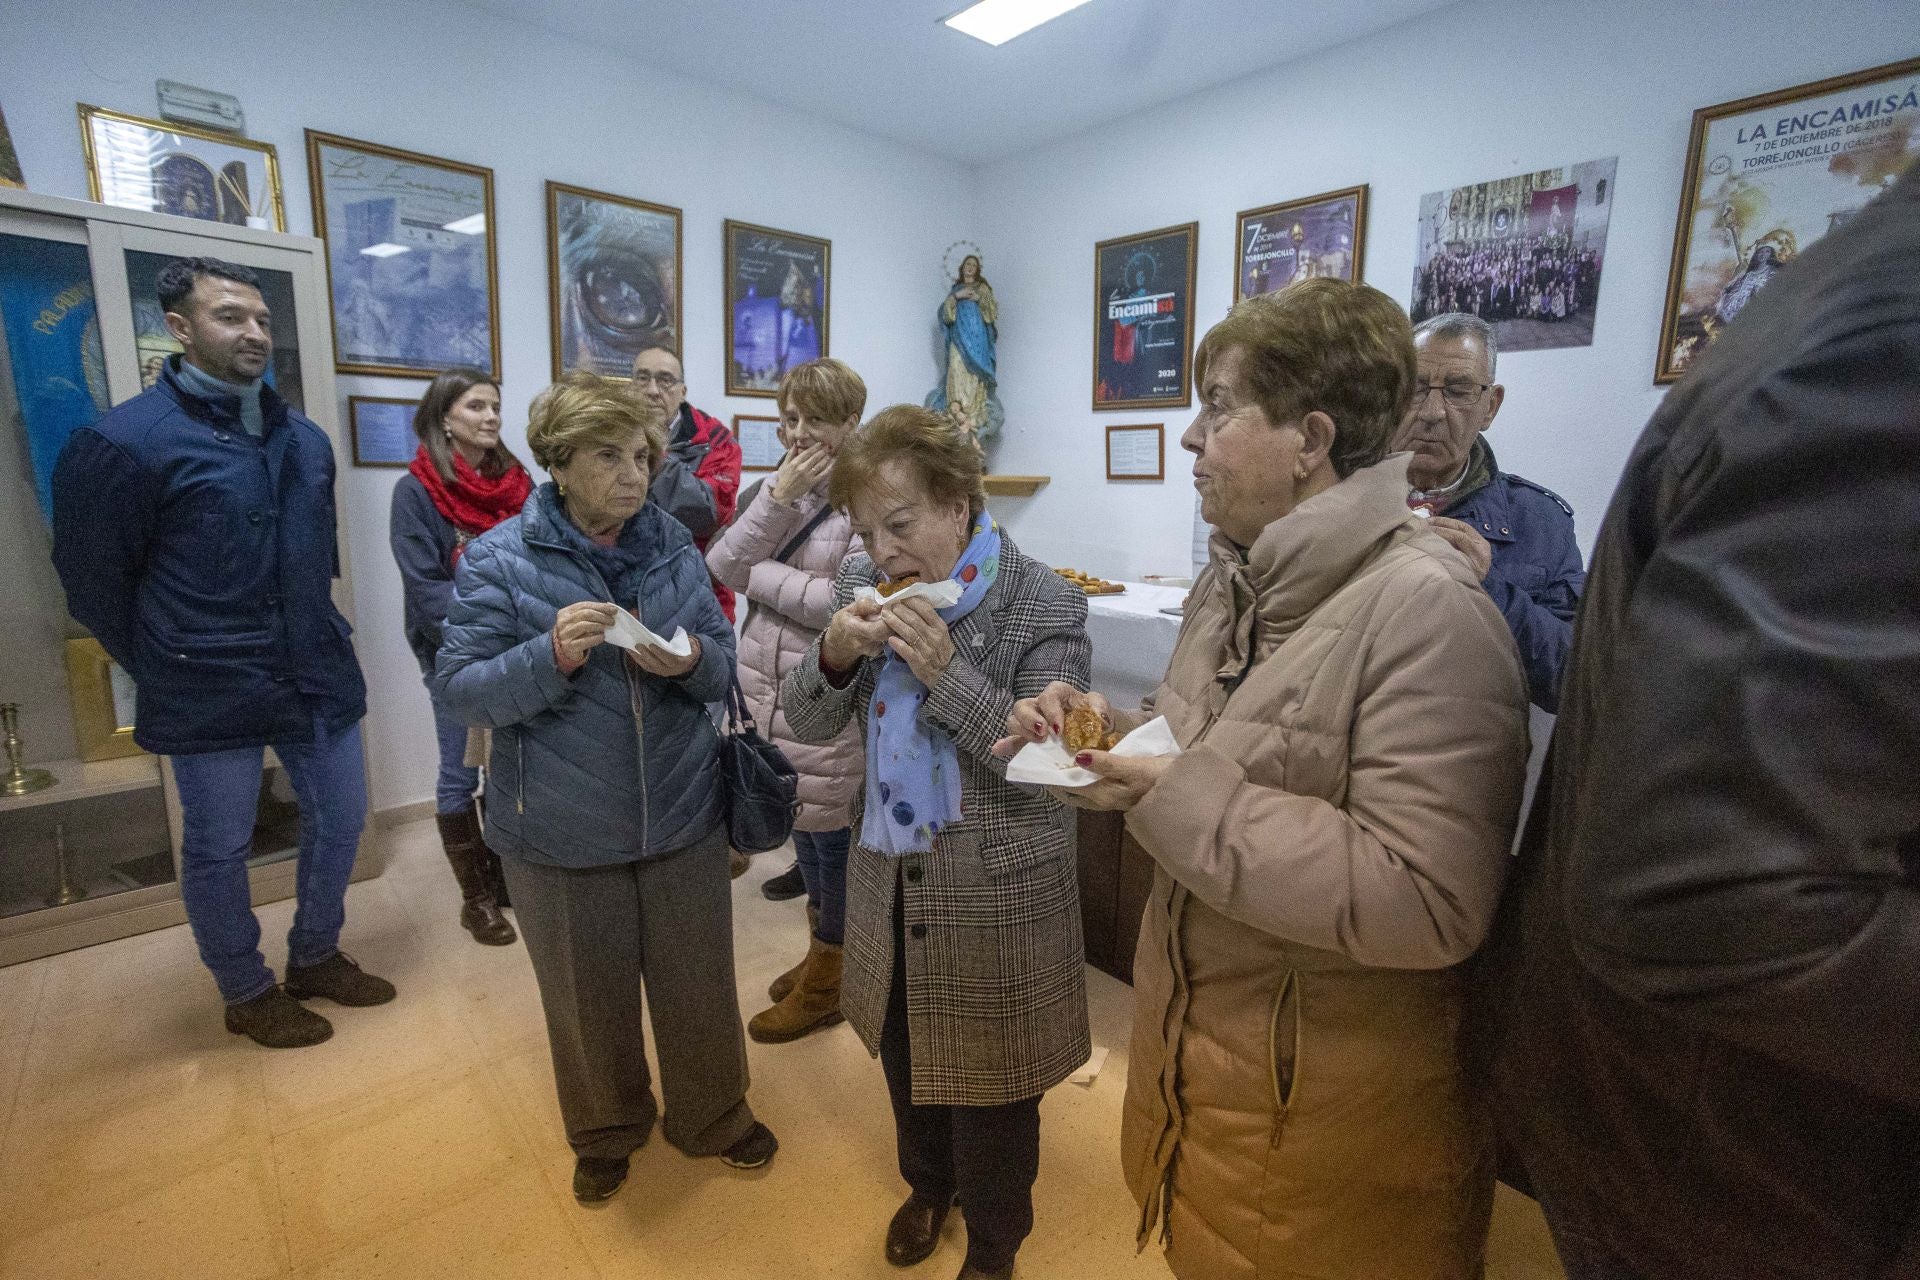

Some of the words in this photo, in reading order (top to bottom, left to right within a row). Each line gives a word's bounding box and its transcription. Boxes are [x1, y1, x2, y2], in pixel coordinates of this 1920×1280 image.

[1737, 123, 1767, 144] LA
[1775, 84, 1919, 136] ENCAMISÁ
[1754, 143, 1761, 152] 7
[1763, 138, 1778, 151] DE
[1780, 126, 1842, 148] DICIEMBRE
[1845, 122, 1863, 134] DE
[1866, 116, 1893, 132] 2018
[1742, 141, 1840, 169] TORREJONCILLO
[1247, 223, 1262, 254] 7
[1245, 248, 1295, 263] TORREJONCILLO
[1158, 369, 1176, 378] 2020
